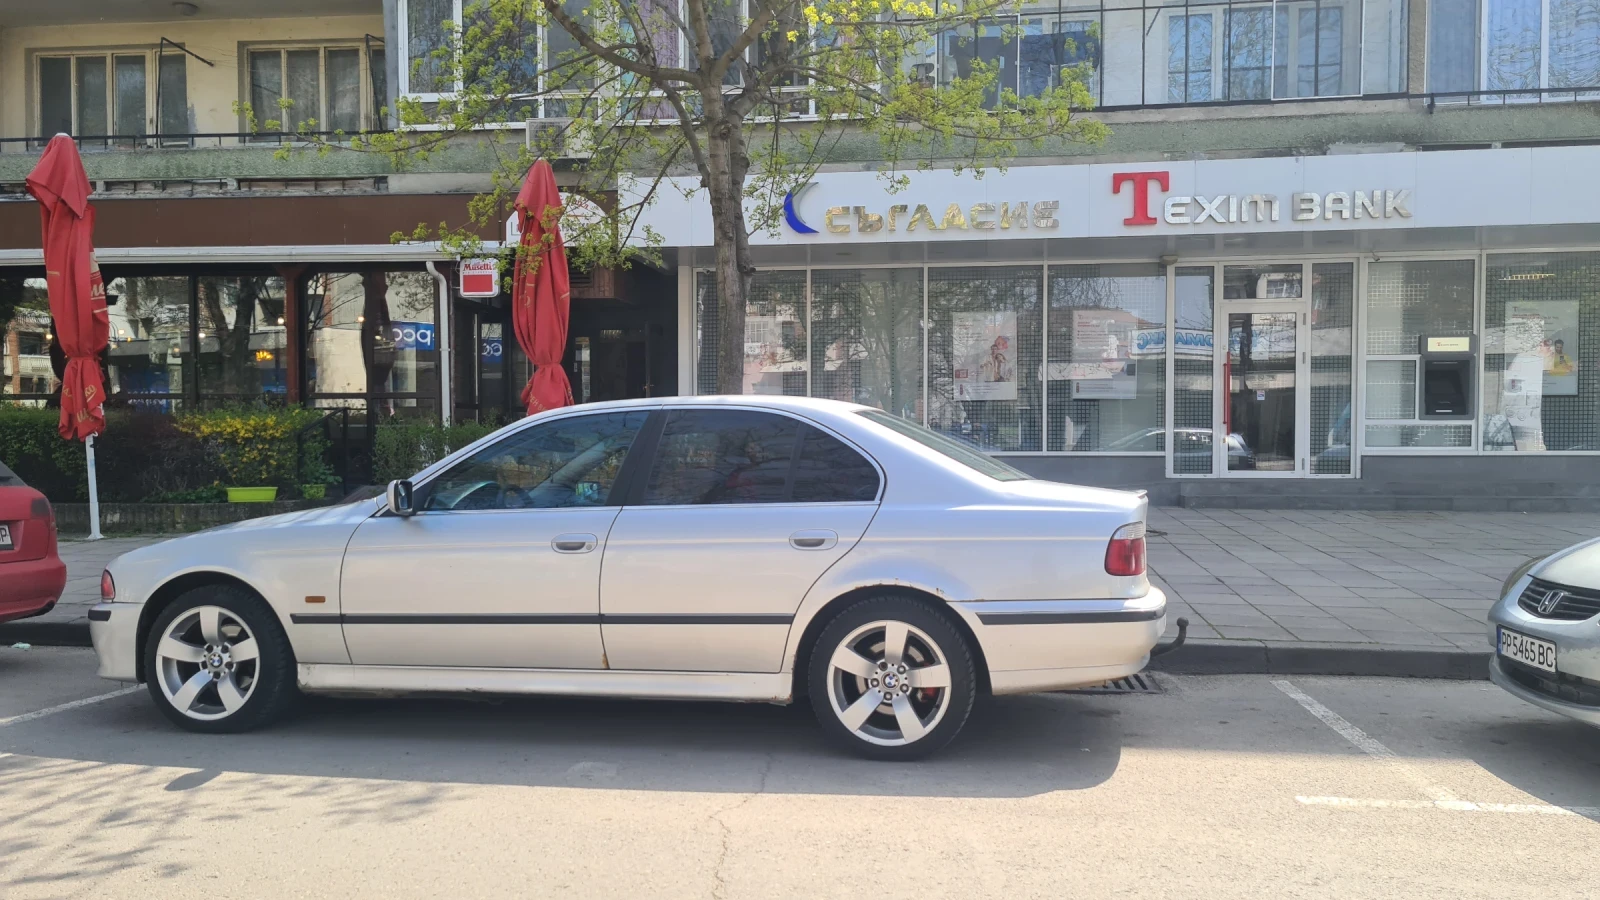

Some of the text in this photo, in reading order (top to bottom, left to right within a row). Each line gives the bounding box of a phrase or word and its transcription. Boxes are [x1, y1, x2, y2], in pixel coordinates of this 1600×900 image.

[825, 200, 1060, 233] СЪГЛАСИЕ
[1112, 171, 1413, 226] TEXIM BANK
